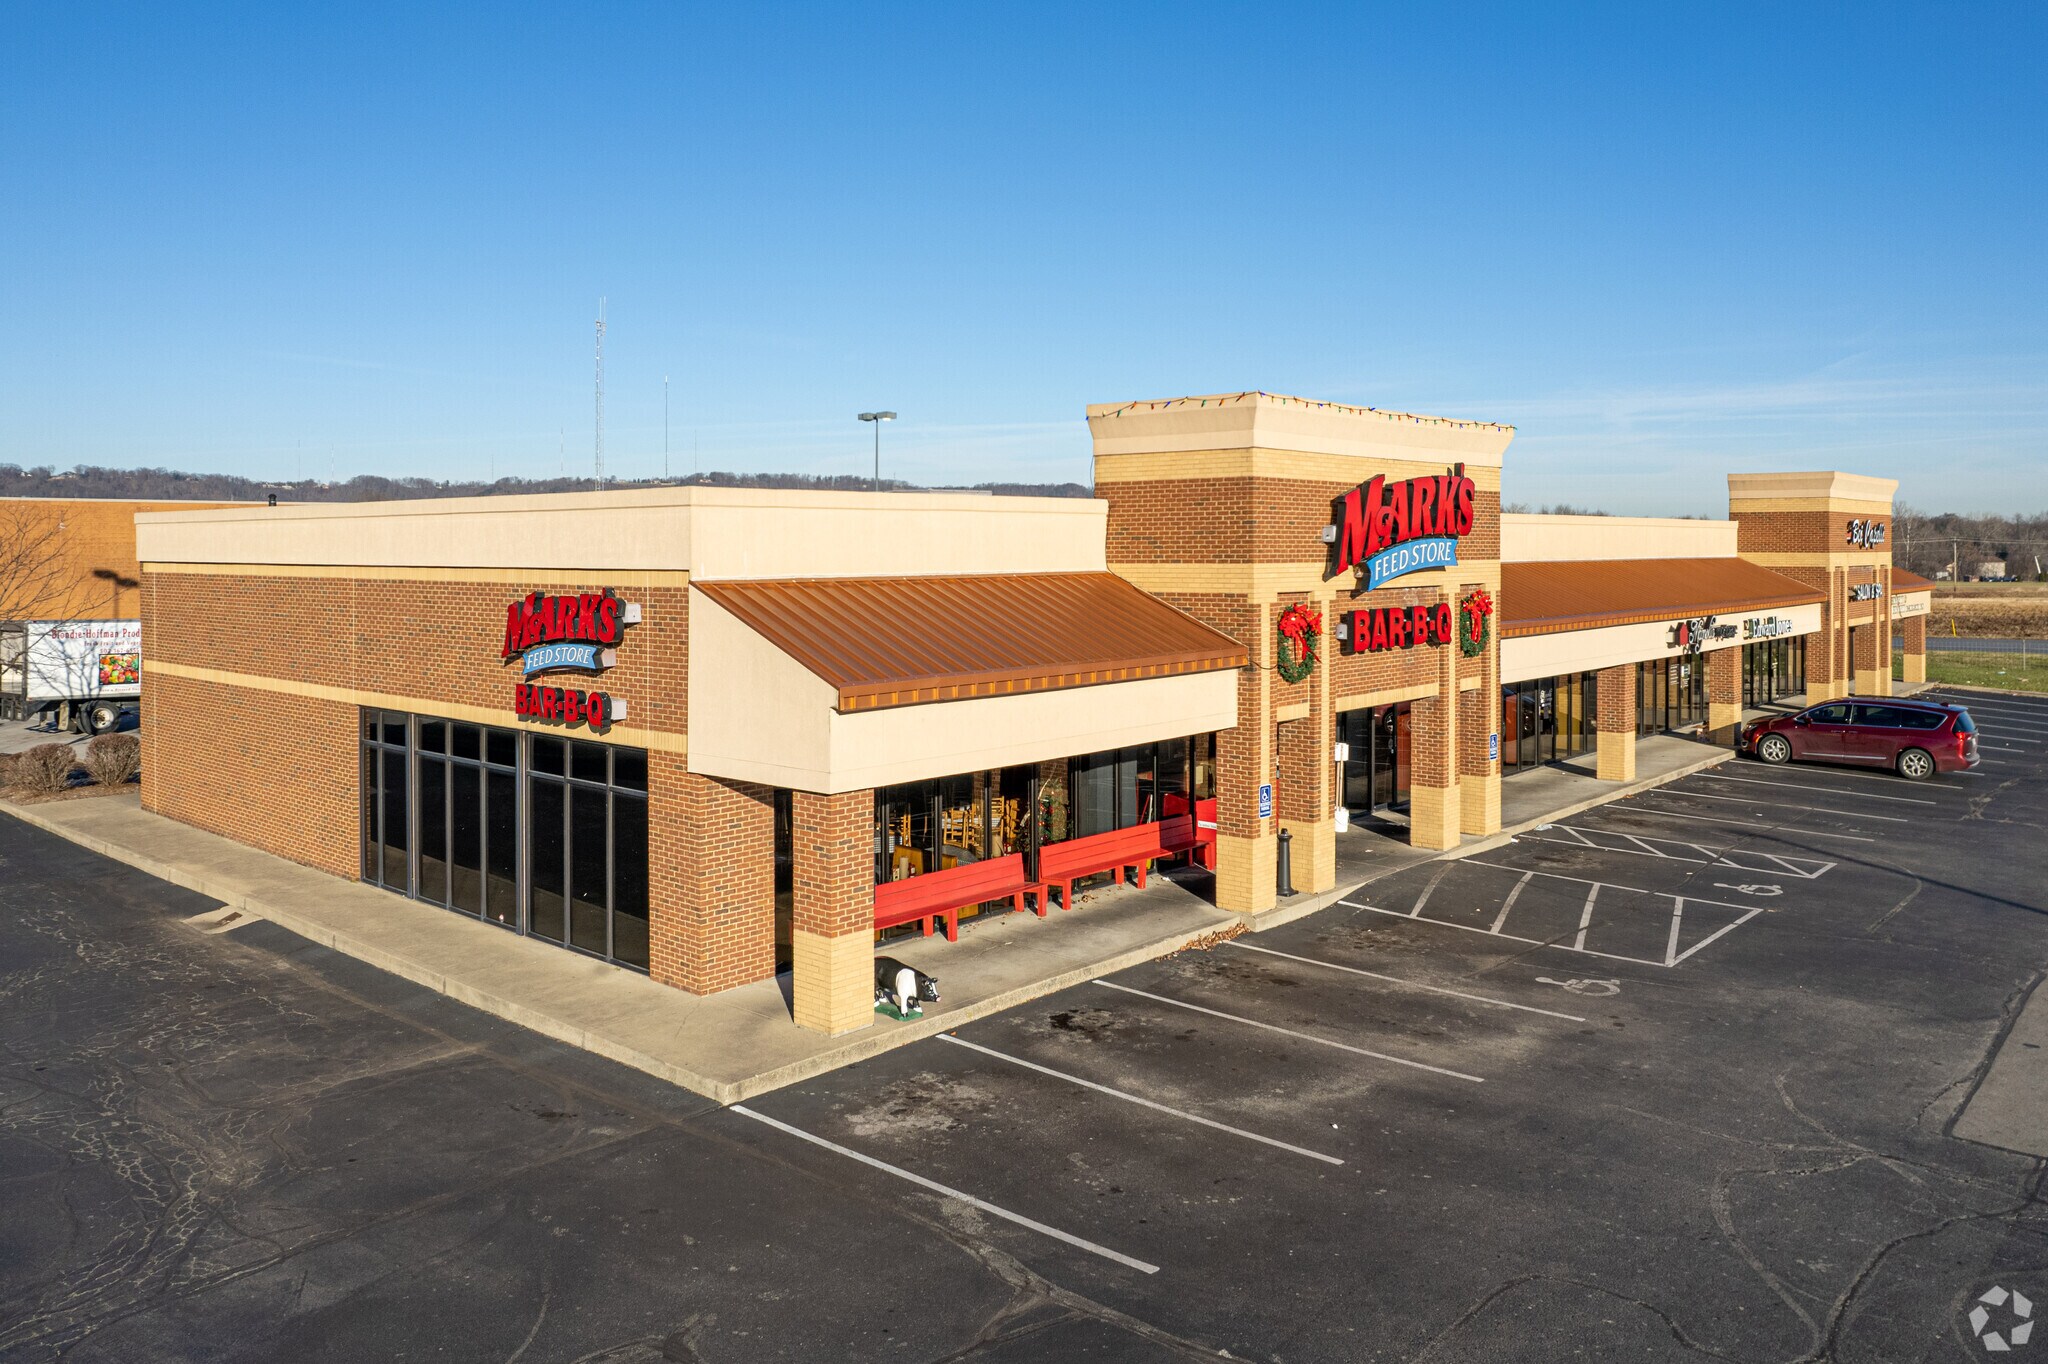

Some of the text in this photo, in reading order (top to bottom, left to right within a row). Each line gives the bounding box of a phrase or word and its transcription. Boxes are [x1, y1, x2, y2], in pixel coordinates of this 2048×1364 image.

[1336, 463, 1475, 576] MARK'S
[1375, 541, 1452, 581] FEED STORE
[501, 587, 618, 658] MARK'S
[1353, 602, 1452, 653] BAR-B-Q
[526, 646, 591, 670] FEED STORE
[516, 683, 604, 729] BAR-B-Q
